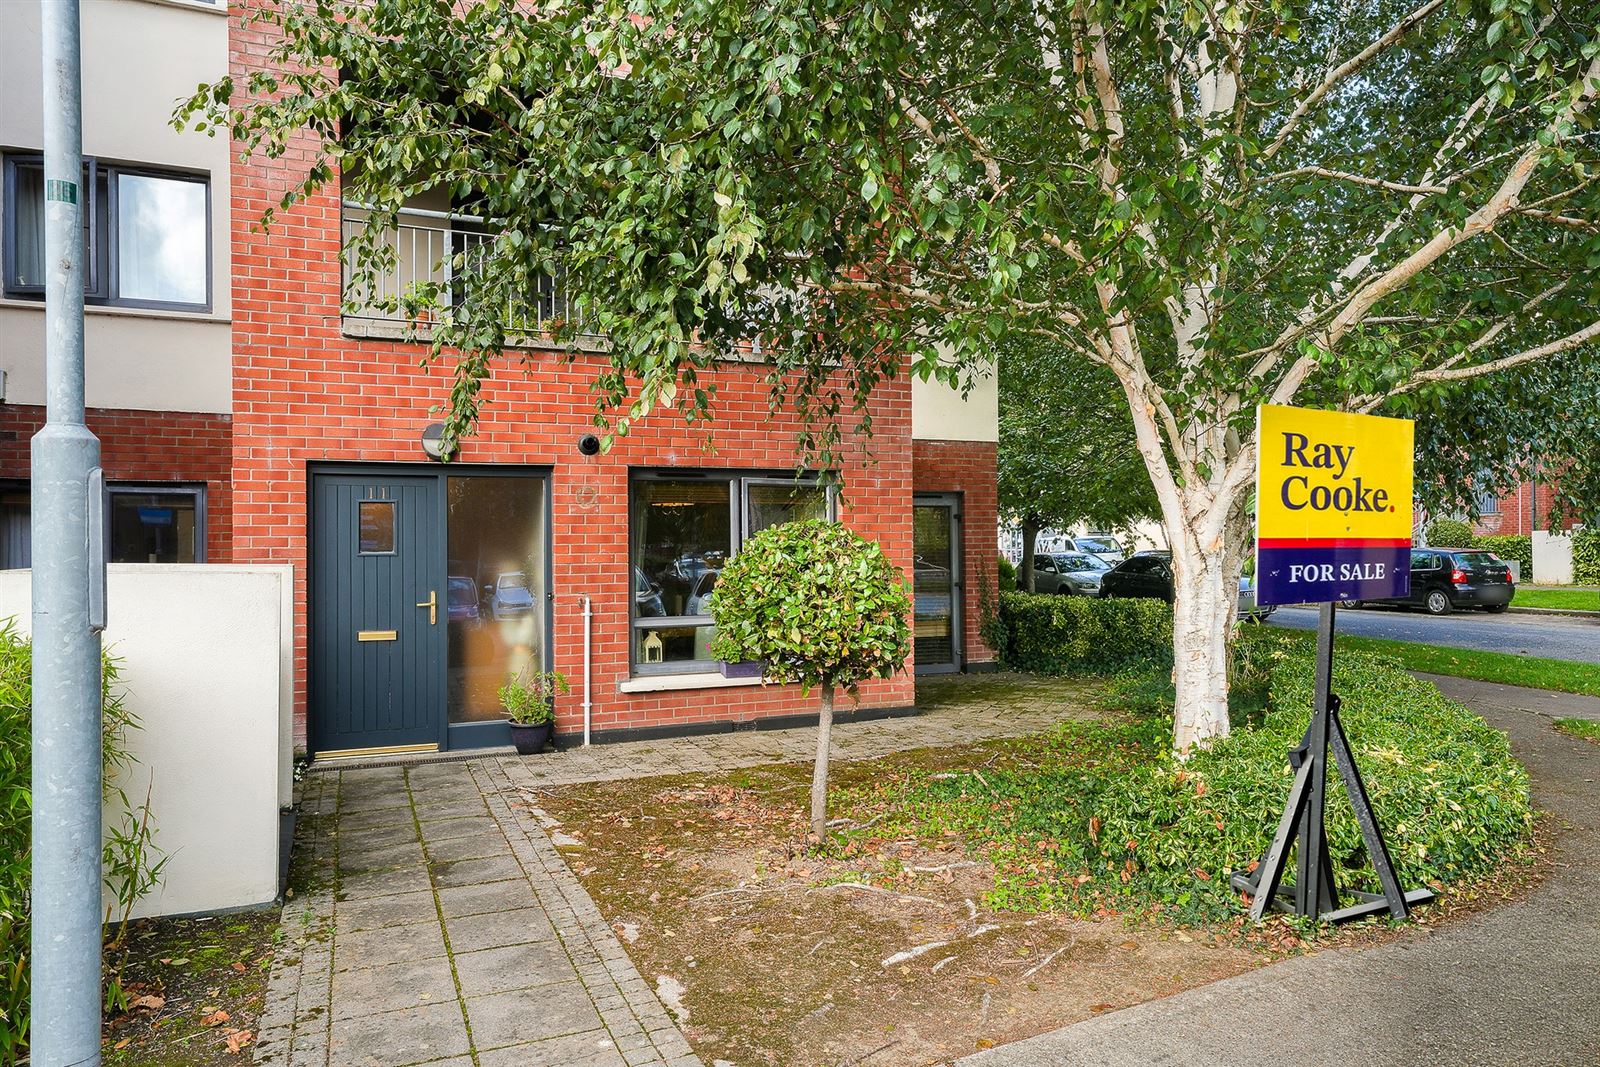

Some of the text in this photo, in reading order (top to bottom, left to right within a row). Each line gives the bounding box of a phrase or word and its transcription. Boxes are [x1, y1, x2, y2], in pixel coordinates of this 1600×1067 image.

[1281, 432, 1355, 480] Ray
[368, 487, 386, 500] 11
[1281, 475, 1395, 513] Cooke.
[1289, 563, 1385, 583] FOR SALE
